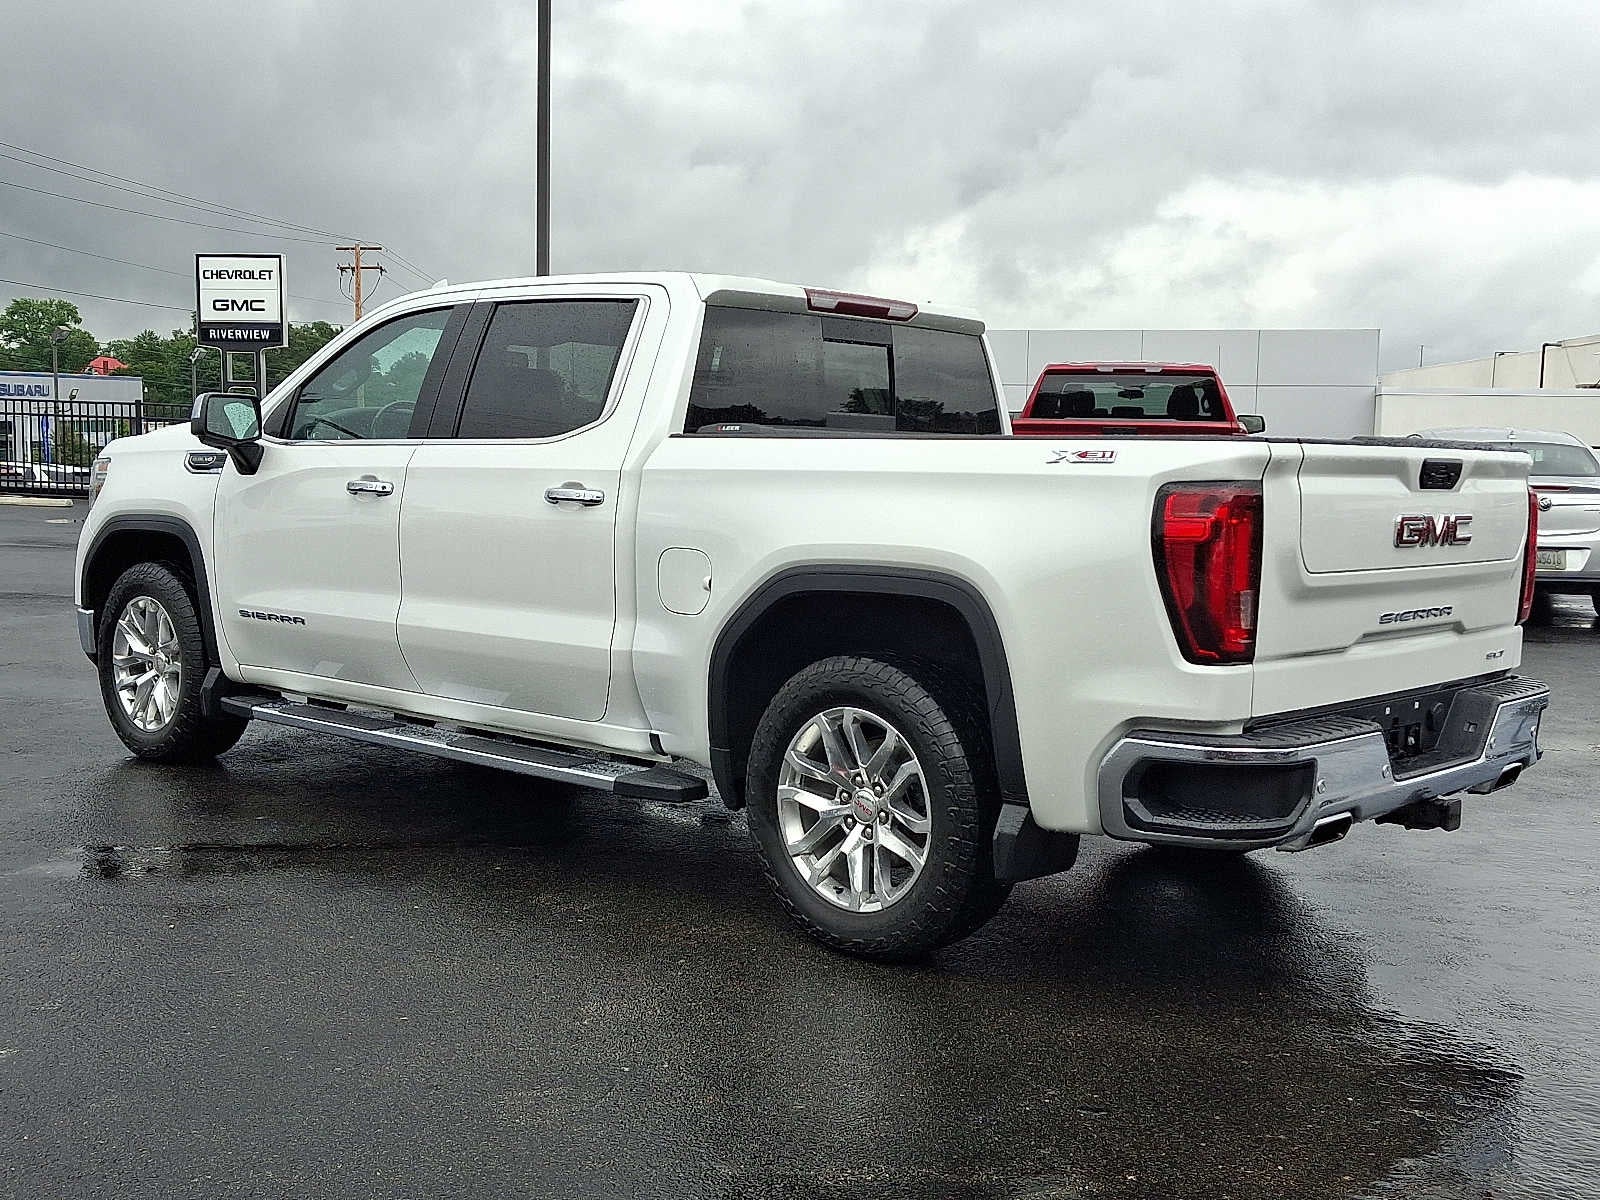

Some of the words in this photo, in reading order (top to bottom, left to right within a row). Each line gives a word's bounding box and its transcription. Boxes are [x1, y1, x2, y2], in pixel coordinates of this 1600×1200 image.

[202, 269, 274, 281] CHEVROLET
[212, 299, 266, 312] GMC
[209, 329, 270, 340] RIVERVIEW
[0, 383, 50, 397] SUBARU
[1393, 514, 1472, 547] GMC
[239, 609, 306, 625] SIERRA
[1379, 606, 1453, 624] SIERRA
